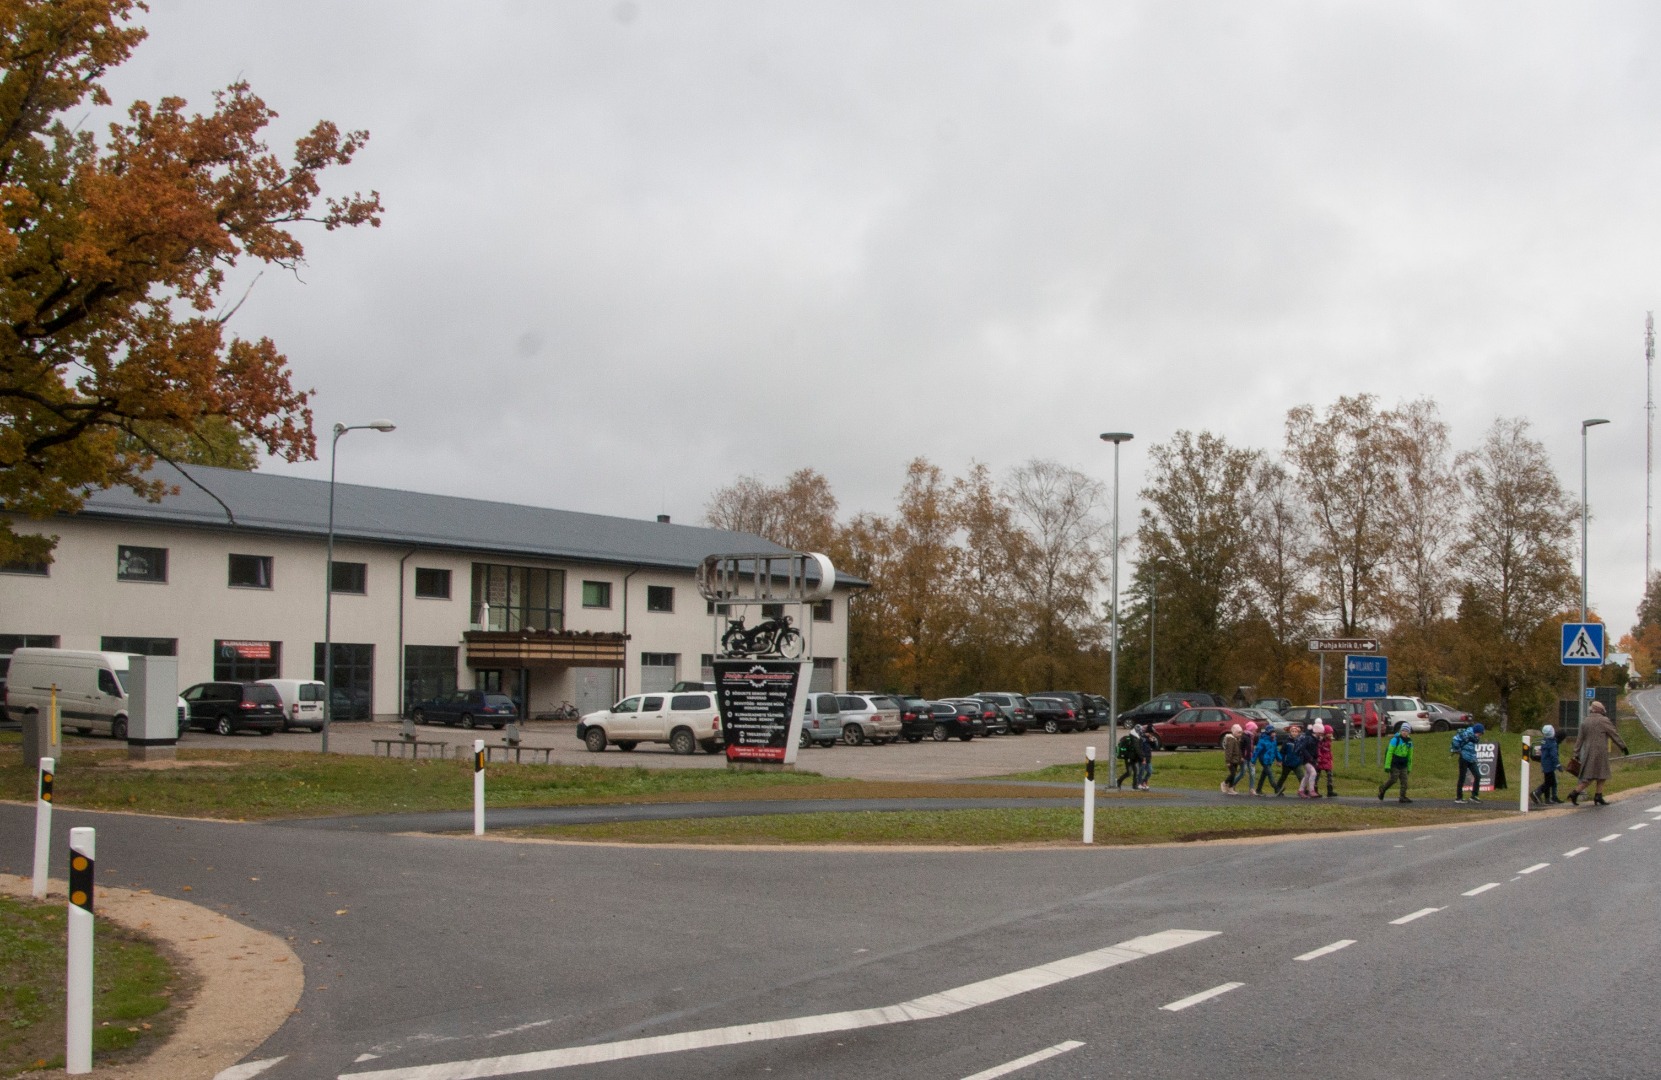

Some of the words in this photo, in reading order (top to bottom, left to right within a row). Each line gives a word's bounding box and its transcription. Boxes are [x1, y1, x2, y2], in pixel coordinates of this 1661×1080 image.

[1355, 662, 1374, 672] VILJANDI
[1355, 683, 1368, 692] TARTU
[1474, 744, 1495, 752] UTO
